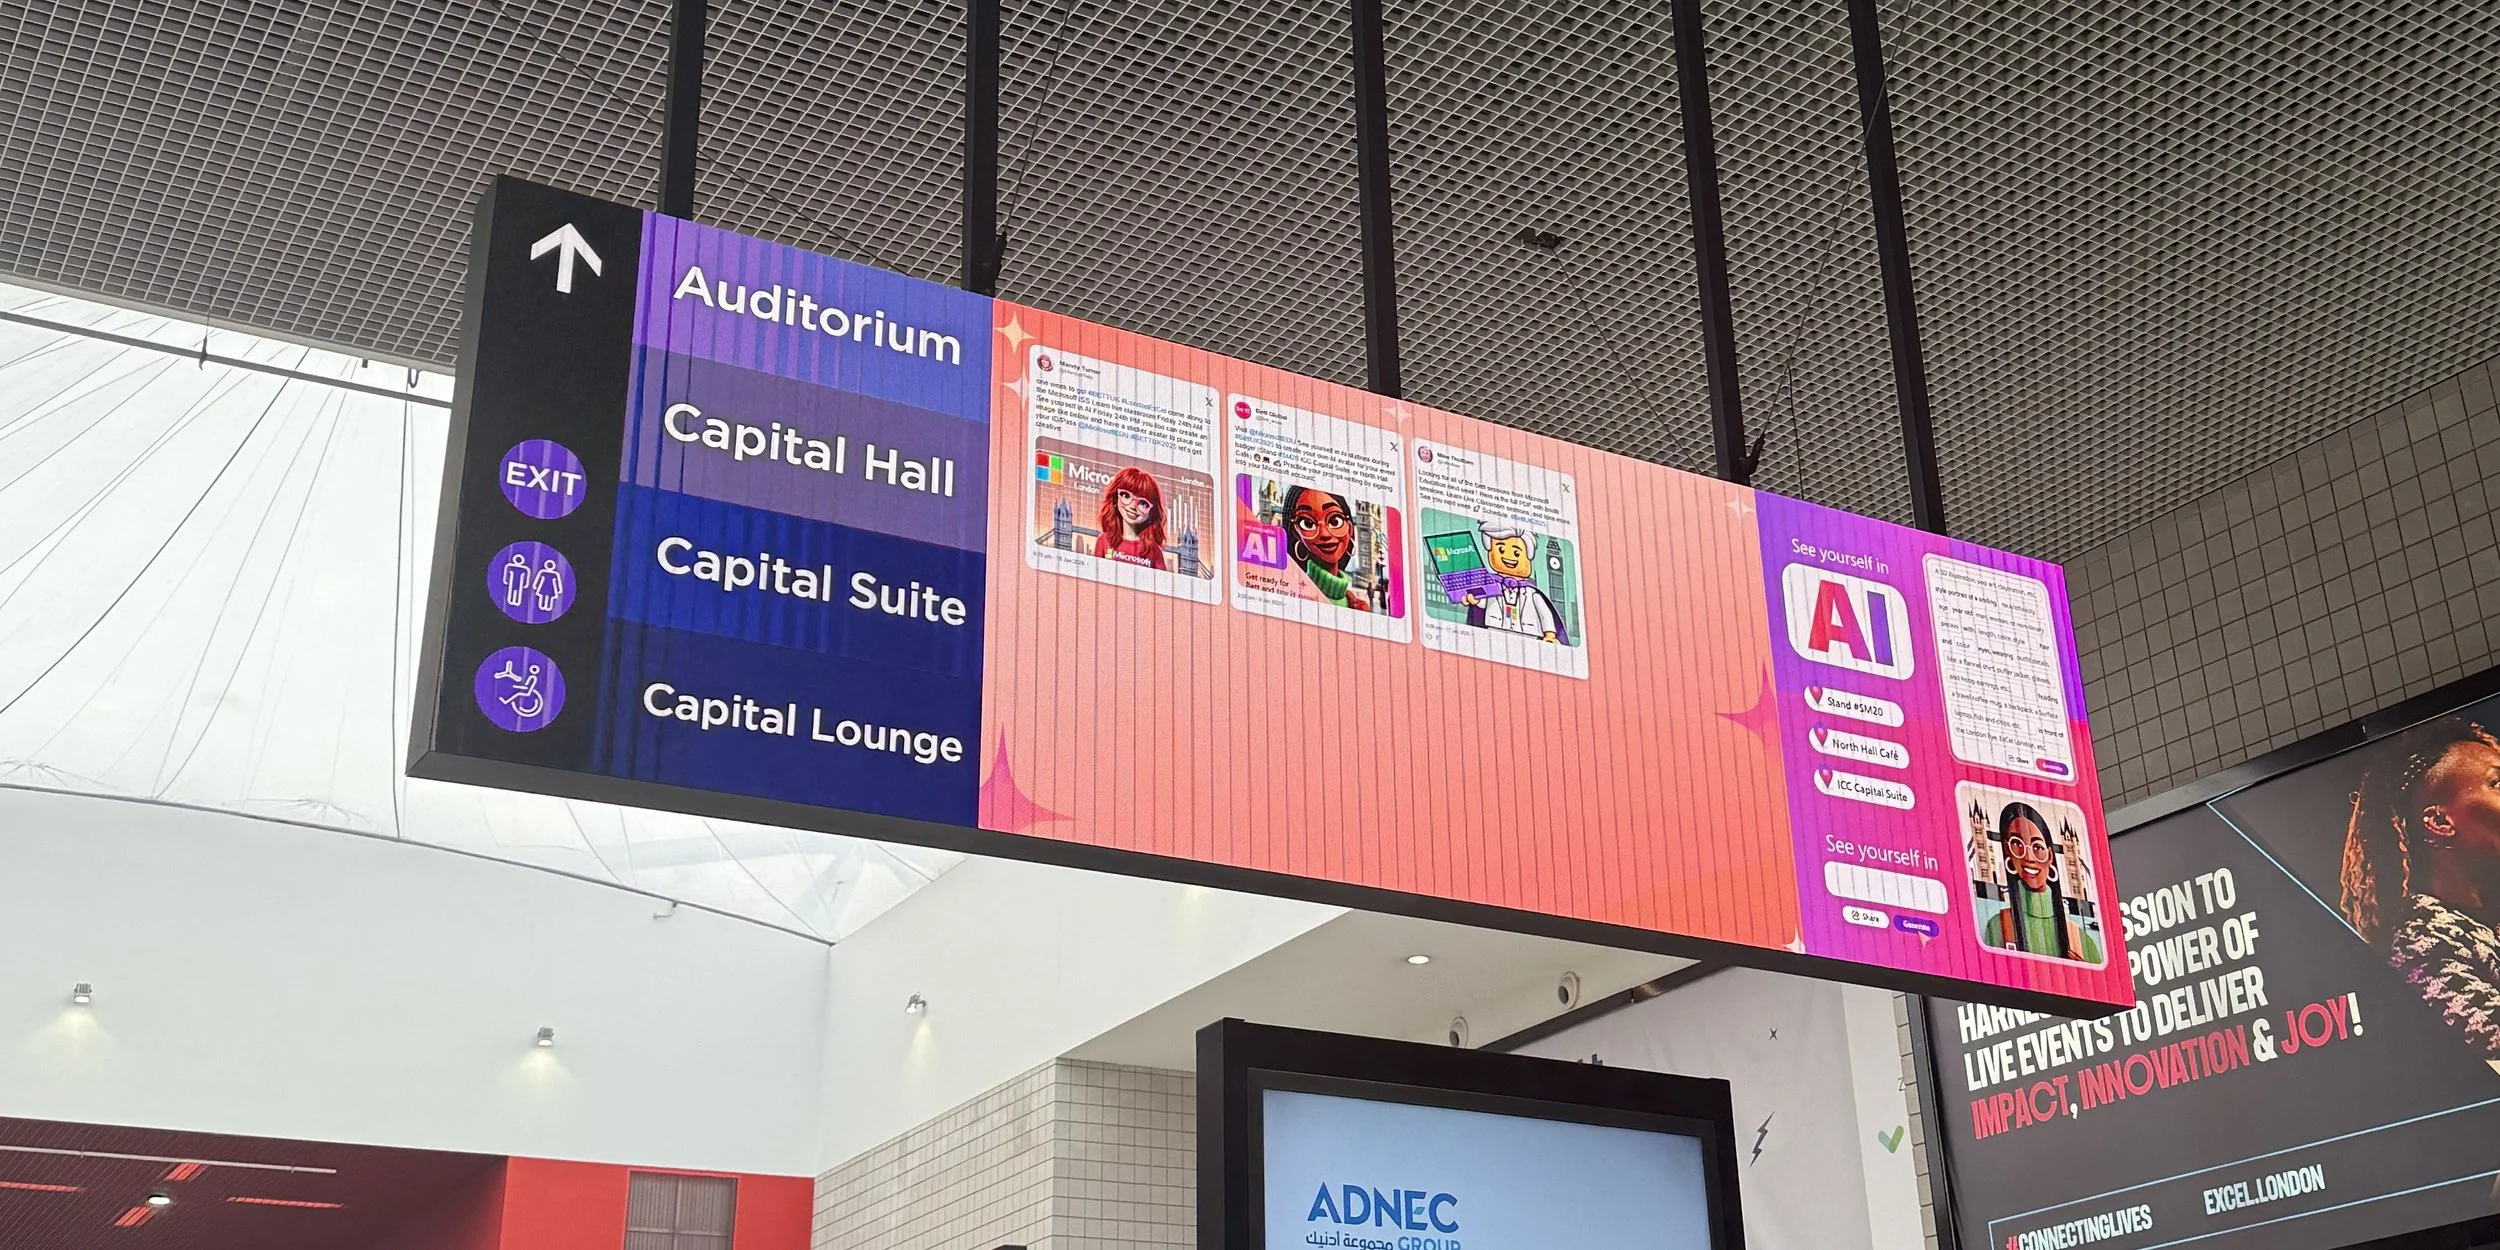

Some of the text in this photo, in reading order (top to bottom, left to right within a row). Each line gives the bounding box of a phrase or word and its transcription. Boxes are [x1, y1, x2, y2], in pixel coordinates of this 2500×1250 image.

[673, 266, 961, 365] Auditorium
[663, 403, 954, 497] Capital Hall
[506, 461, 582, 496] EXIT
[1069, 462, 1113, 488] Micro
[1074, 480, 1100, 495] London
[1182, 475, 1204, 488] London
[1113, 550, 1151, 568] Microsoft
[1242, 530, 1277, 565] AI
[1792, 538, 1889, 575] See yourself in
[657, 536, 966, 626] Capital Suite
[1246, 571, 1258, 581] Get
[1808, 579, 1895, 666] AI
[643, 683, 963, 764] Capital Lounge
[1828, 696, 1883, 717] Stand #SM20
[1833, 739, 1898, 761] North Hall Café
[1838, 780, 1907, 802] ICC Capital Suite
[1826, 833, 1938, 871] See yourself in
[2119, 867, 2236, 942] SSION TO
[2127, 911, 2260, 986] POWER OF
[1963, 966, 2269, 1092] LIVE EVENTS TO DELIVER
[1971, 991, 2364, 1140] IMPACT, INNOVATION & JOY!
[1307, 1181, 1460, 1234] ADNEC
[2203, 1164, 2326, 1216] EXCEL.LONDON
[1398, 1236, 1461, 1250] GROUP
[2006, 1204, 2153, 1250] #CONNECTINGLIVES
